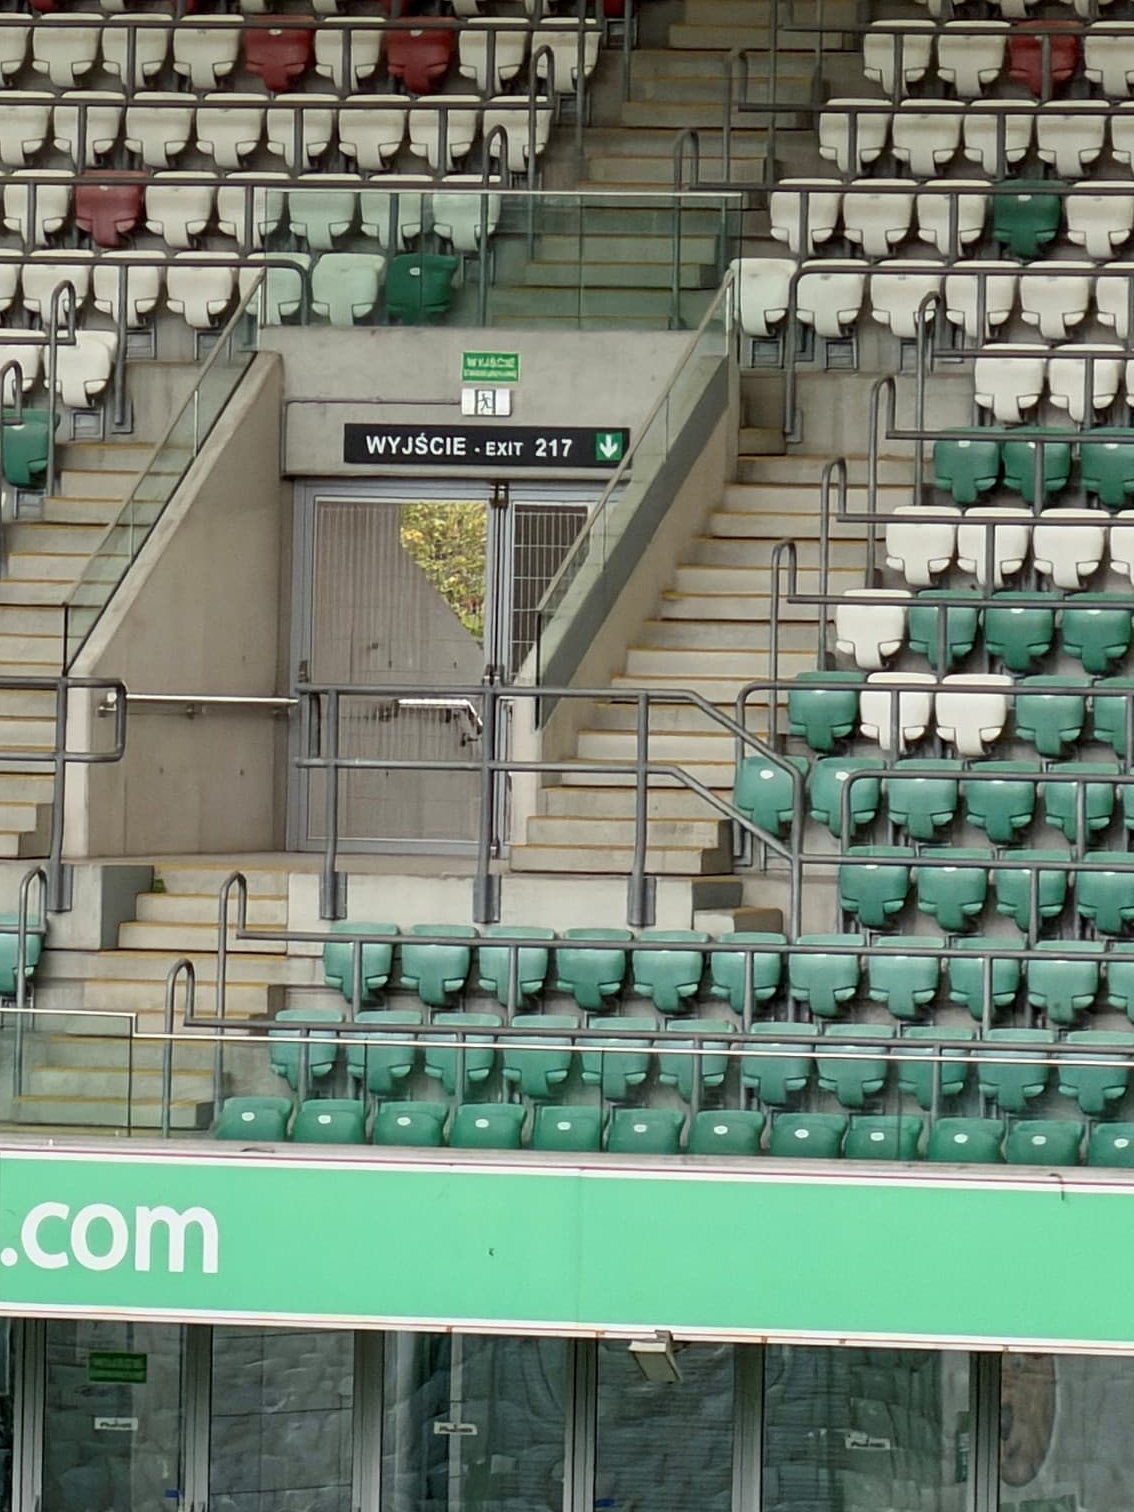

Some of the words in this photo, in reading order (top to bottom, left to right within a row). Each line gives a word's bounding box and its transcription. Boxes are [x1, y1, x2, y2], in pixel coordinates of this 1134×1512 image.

[366, 432, 466, 456] WYJŚCIE
[485, 440, 524, 457] EXIT
[535, 437, 573, 458] 217
